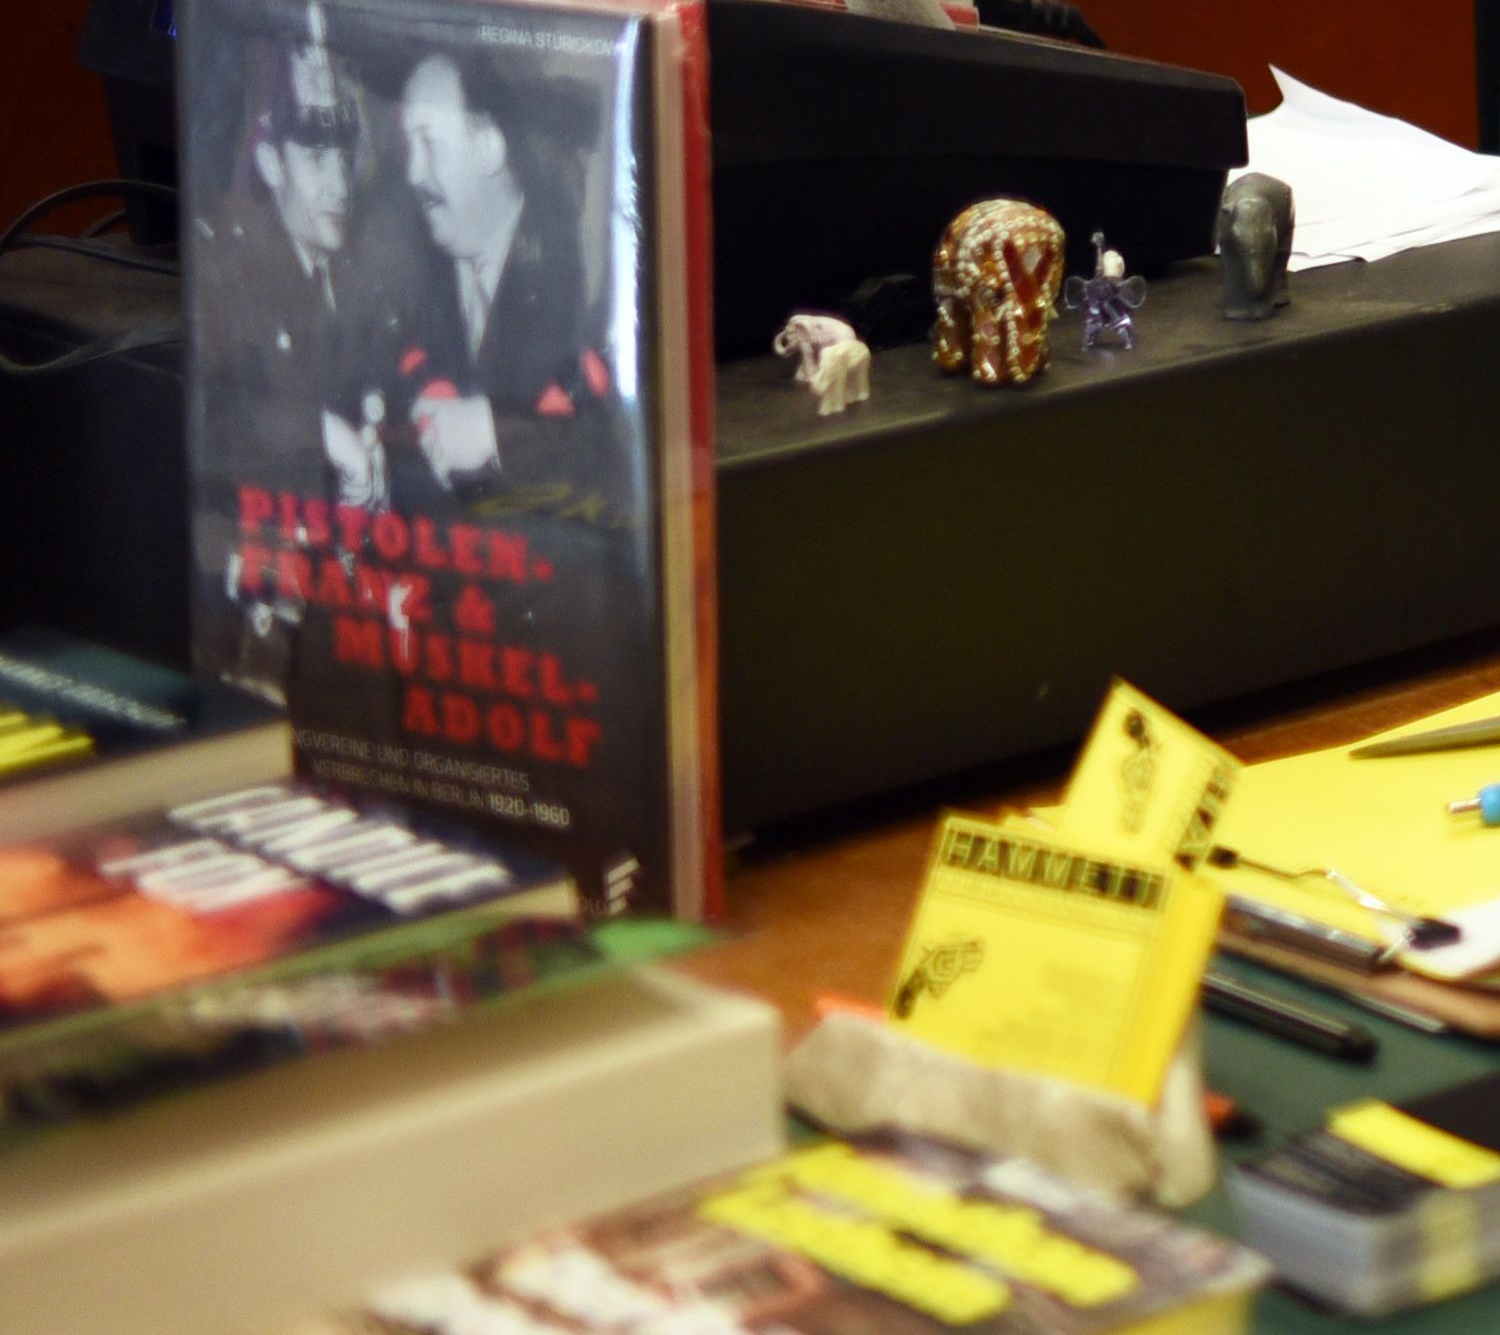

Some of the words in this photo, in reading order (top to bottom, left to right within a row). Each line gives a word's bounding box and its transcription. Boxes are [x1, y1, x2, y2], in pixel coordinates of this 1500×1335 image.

[481, 24, 532, 48] REGINA
[236, 541, 433, 623] FRANZ
[455, 583, 495, 634] &
[404, 684, 602, 767] ADOLF
[312, 756, 411, 794] VERBRECHEN
[432, 778, 485, 812] BERLIN
[377, 741, 409, 768] UND
[413, 750, 530, 793] ORGANISIERTES
[944, 829, 1168, 913] HAMMETT
